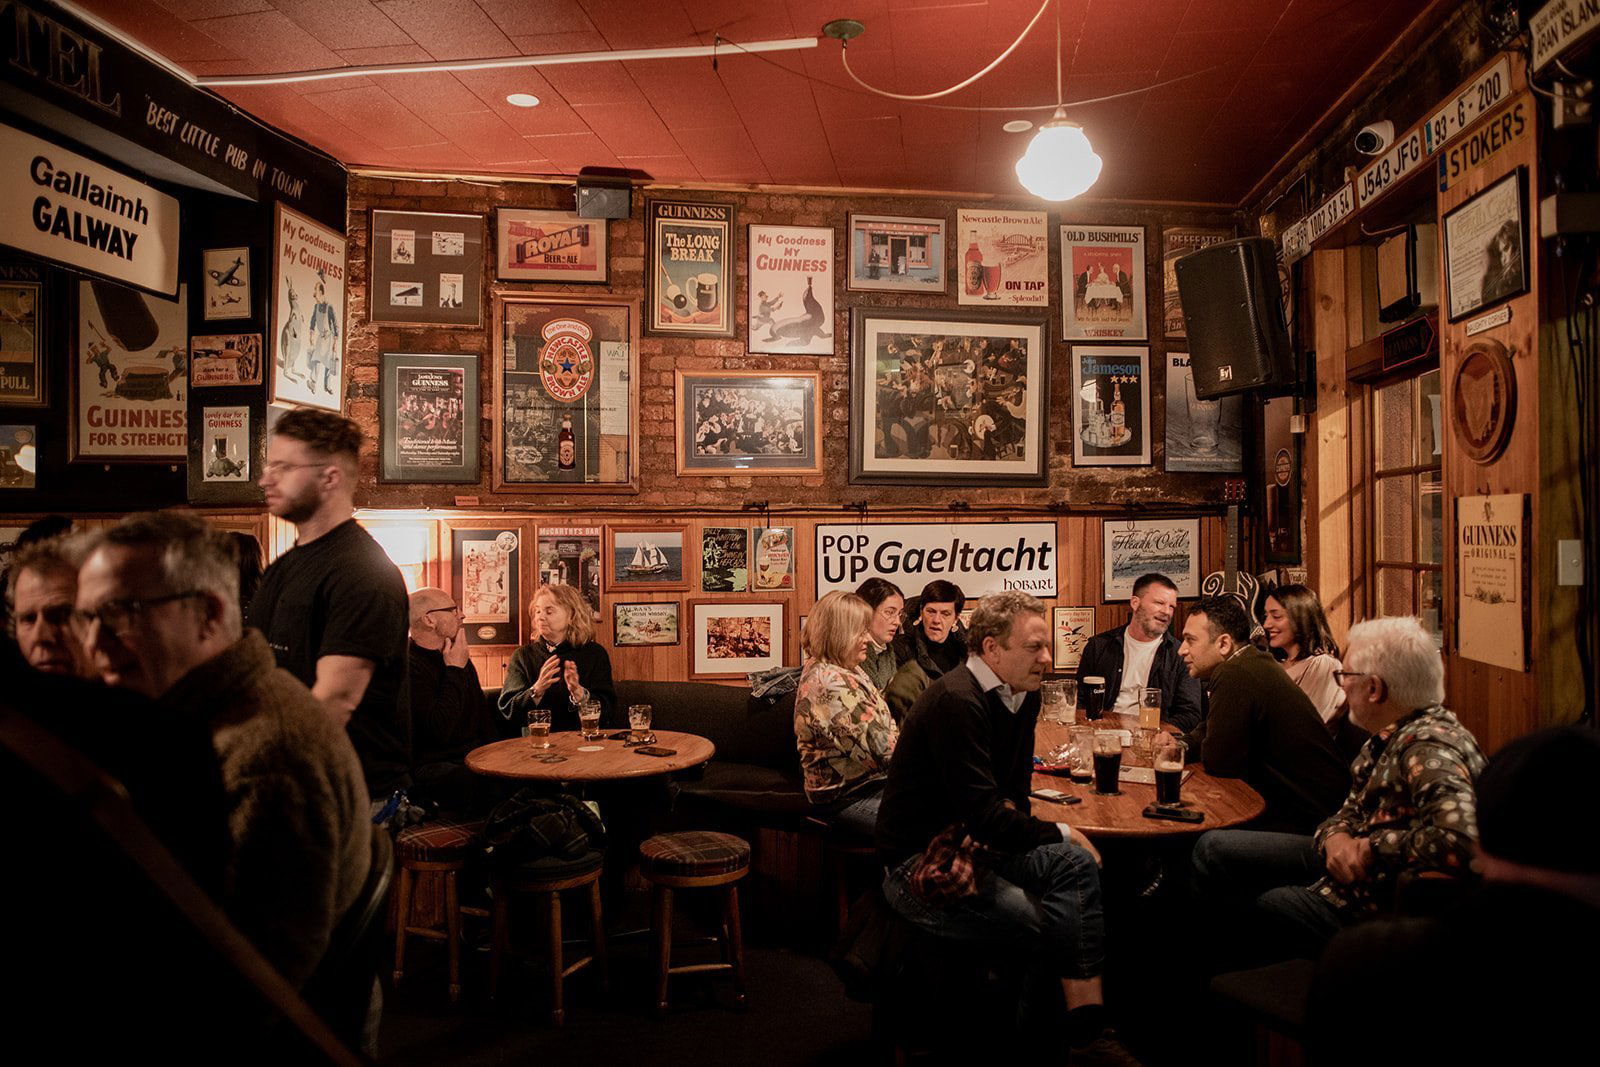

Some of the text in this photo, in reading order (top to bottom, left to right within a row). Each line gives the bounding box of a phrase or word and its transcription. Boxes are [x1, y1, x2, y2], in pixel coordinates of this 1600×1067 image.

[1536, 22, 1559, 58] ARAN
[1451, 104, 1524, 177] STOKERS
[180, 121, 220, 157] LITTLE
[225, 144, 249, 170] PUB
[252, 158, 267, 181] IN
[1361, 136, 1419, 201] J543 JFG
[30, 155, 149, 226] Gallaimh
[658, 204, 726, 219] GUINNESS
[962, 214, 1043, 225] Newcastle Brown Ale
[32, 195, 139, 262] GALWAY
[283, 218, 296, 240] My
[525, 226, 581, 258] ROYAL
[665, 233, 721, 249] The LONG
[757, 234, 826, 247] My Goodness
[544, 253, 560, 264] BEER
[566, 255, 578, 264] ALE
[670, 247, 715, 262] BREAK
[784, 247, 800, 257] MY
[284, 243, 343, 281] My GUINNESS
[756, 254, 827, 272] GUINNESS
[1005, 281, 1045, 291] ON TAP
[1084, 329, 1125, 337] WHISKEY
[546, 337, 588, 361] NEWCASTLE
[1082, 357, 1140, 375] Jameson
[0, 376, 30, 390] PULL
[196, 373, 234, 381] GUINNESS
[547, 376, 588, 397] BROWN ALE
[87, 405, 187, 428] GUINNES
[208, 420, 242, 428] GUINNESS
[89, 433, 118, 447] FOR
[822, 535, 869, 554] POP
[1463, 525, 1517, 547] GUINNESS
[873, 537, 1052, 574] Gaeltacht
[1471, 548, 1507, 559] ORIGINAL
[824, 555, 869, 583] UP
